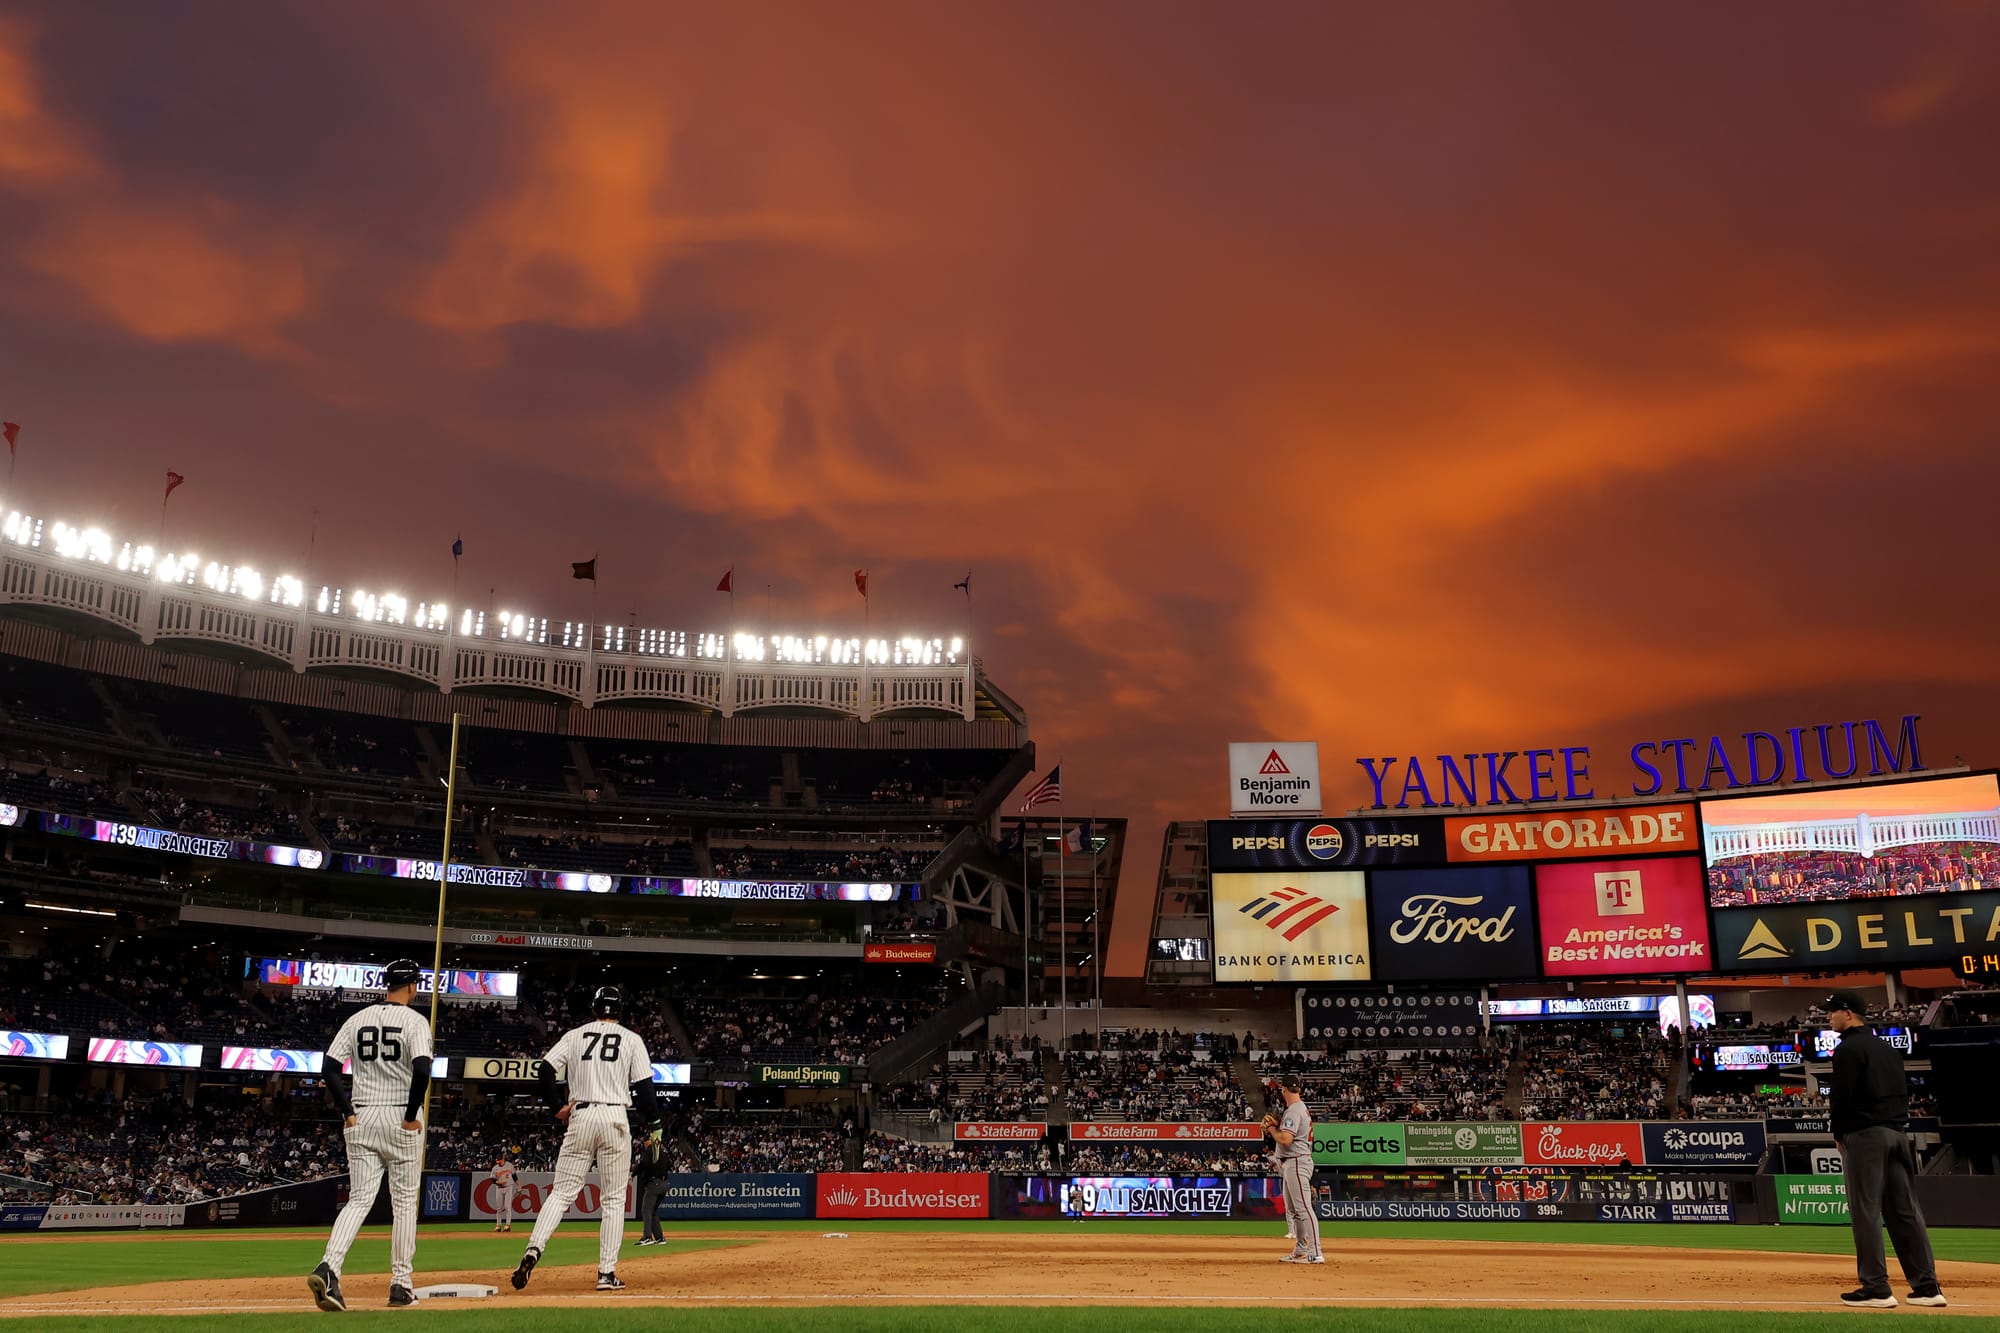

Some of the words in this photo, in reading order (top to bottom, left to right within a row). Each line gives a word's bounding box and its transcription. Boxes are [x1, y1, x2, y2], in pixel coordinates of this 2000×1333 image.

[1356, 747, 1593, 809] YANKEE
[1630, 714, 1926, 797] STADIUM
[1240, 777, 1311, 793] Benjamin
[1249, 792, 1299, 805] Moore
[117, 824, 137, 846] 39
[135, 829, 160, 850] ALI
[1460, 812, 1685, 854] GATORADE
[1232, 835, 1285, 850] PEPSI
[1308, 837, 1341, 848] PEPSI
[1365, 833, 1420, 848] PEPSI
[417, 861, 435, 880] 39
[703, 880, 720, 897] 39
[1389, 894, 1517, 944] Ford
[495, 935, 526, 945] Audi
[529, 936, 569, 947] YANKEES
[571, 938, 593, 948] CLUB
[1564, 923, 1683, 944] America's
[885, 949, 932, 959] Budweiser
[1548, 945, 1600, 963] Best
[1602, 940, 1704, 961] Network
[1218, 954, 1263, 969] BANK
[1267, 954, 1288, 968] OF
[1290, 953, 1366, 967] AMERICA
[1962, 954, 2000, 974] 0:14
[357, 1026, 403, 1062] 85
[581, 1031, 622, 1062] 78
[1819, 1037, 1834, 1050] 39
[762, 1066, 801, 1081] Poland
[802, 1066, 841, 1084] Spring
[1408, 1125, 1452, 1137] Morningside
[1476, 1125, 1517, 1135] Workmen's
[1795, 1122, 1823, 1130] WATCH
[1350, 1136, 1401, 1154] Eats
[1495, 1135, 1517, 1144] Circle
[1689, 1130, 1745, 1150] coupa
[1664, 1152, 1684, 1160] Make
[1685, 1152, 1714, 1162] Margins
[431, 1180, 455, 1191] NEW
[665, 1182, 737, 1197] ontefiore
[740, 1182, 801, 1197] Einstein
[1789, 1185, 1805, 1194] HIT
[1808, 1185, 1832, 1194] HERE
[428, 1190, 457, 1201] YORK
[473, 1178, 632, 1214] Cao
[864, 1188, 980, 1208] Budweiser
[1095, 1188, 1130, 1212] ALI
[1131, 1184, 1230, 1212] SÁNCHEZ
[281, 1201, 298, 1210] CLEAR
[430, 1200, 453, 1211] LIFE
[1321, 1203, 1382, 1217] StubHub
[1388, 1203, 1451, 1218] StubHub
[1456, 1204, 1521, 1218] StubHub
[1537, 1205, 1557, 1216] 399
[1602, 1205, 1657, 1219] STARR
[1672, 1204, 1728, 1214] CUTWATER
